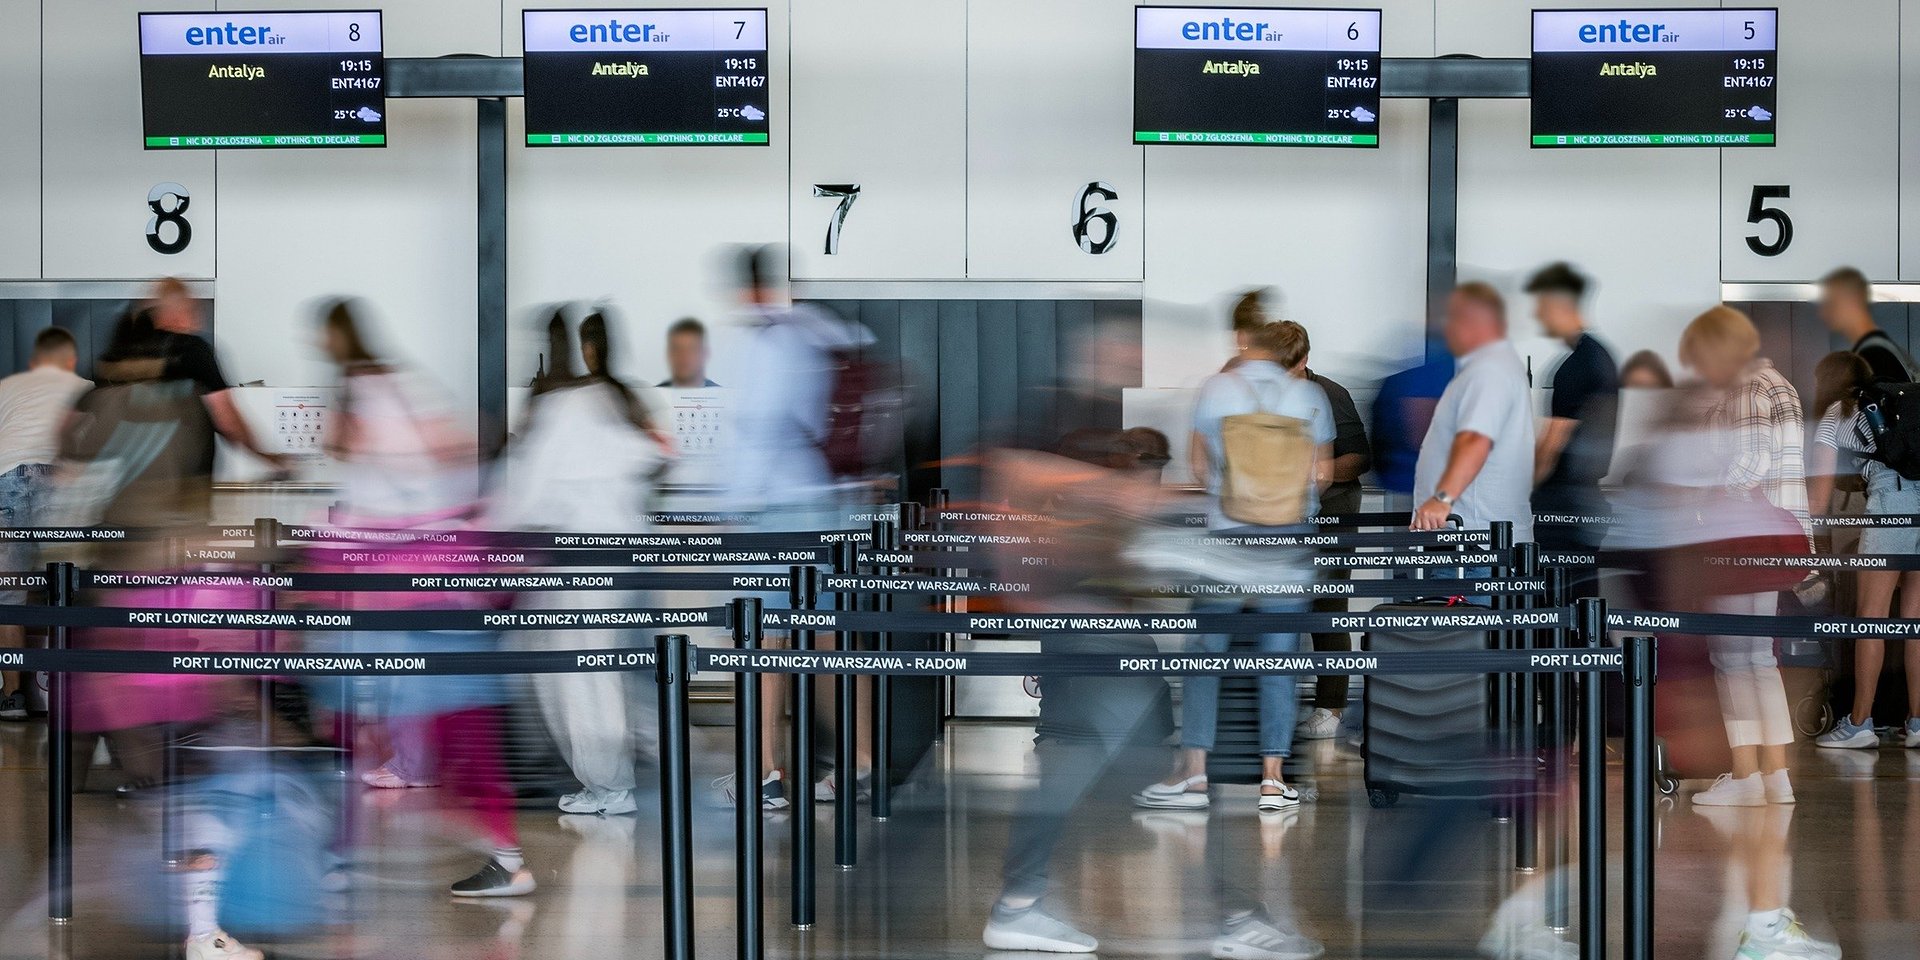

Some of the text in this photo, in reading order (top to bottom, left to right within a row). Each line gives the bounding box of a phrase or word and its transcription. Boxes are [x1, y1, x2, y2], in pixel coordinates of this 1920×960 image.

[186, 22, 286, 46] enter air
[349, 23, 361, 41] 8
[569, 19, 670, 43] enter air
[733, 21, 746, 40] 7
[1182, 18, 1283, 42] enter air
[1347, 21, 1359, 40] 6
[1578, 19, 1679, 43] enter air
[1744, 21, 1755, 40] 5
[340, 60, 371, 71] 19:15
[591, 61, 649, 78] Antalya
[724, 59, 756, 69] 19:15
[1202, 60, 1260, 77] Antalya
[1337, 59, 1368, 70] 19:15
[1733, 59, 1765, 70] 19:15
[208, 64, 265, 80] Antalya
[1599, 62, 1657, 78] Antalya
[331, 78, 381, 89] ENT4167
[715, 76, 765, 87] ENT4167
[1327, 77, 1377, 88] ENT4167
[1724, 76, 1774, 87] ENT4167
[202, 137, 213, 145] DO
[312, 136, 323, 144] TO
[325, 136, 360, 144] DECLARE
[568, 134, 743, 143] NIC DO NOTHING TO DECLARE
[1192, 134, 1203, 142] DO
[1266, 135, 1302, 143] NOTHING
[1304, 135, 1315, 143] TO
[1317, 135, 1352, 143] DECLARE
[1574, 135, 1749, 144] NIC DO NOTHING DECLARE
[145, 181, 192, 254] 8
[813, 184, 861, 255] 7
[1071, 180, 1120, 255] 6
[1745, 185, 1793, 257] 5
[849, 513, 871, 522] PORT
[965, 513, 1006, 521] LOTNICZY
[1008, 514, 1056, 522] WARSZAWA
[1538, 515, 1579, 523] LOTNICZY
[33, 530, 125, 539] WARSZAWA RADOM
[223, 529, 247, 537] PORT
[291, 529, 457, 542] PORT LOTNICZY WARSZAWA RADOM
[820, 533, 845, 542] PORT
[905, 533, 1031, 544] PORT LOTNICZY WARSZAWA
[1437, 534, 1461, 542] PORT
[555, 536, 722, 546] PORT LOTNICZY WARSZAWA RADOM
[1198, 538, 1243, 546] LOTNICZY
[1244, 537, 1296, 545] WARSZAWA
[199, 550, 235, 559] RADOM
[343, 553, 524, 563] PORT LOTNICZY WARSZAWA RADOM
[632, 551, 815, 563] PORT LOTNICZY WARSZAWA RADOM
[876, 554, 913, 563] RADOM
[1314, 554, 1497, 566] PORT LOTNICZY WARSZAWA RADOM
[1558, 555, 1595, 564] RADOM
[1022, 557, 1048, 566] PORT
[1734, 558, 1887, 567] LOTNICZY WARSZAWA RADOM
[93, 575, 293, 587] PORT LOTNICZY WARSZAWA RADOM
[412, 577, 613, 587] PORT LOTNICZY WARSZAWA RADOM
[733, 577, 763, 587] PORT
[828, 578, 1030, 592] PORT LOTNICZY WARSZAWA RADOM
[1475, 582, 1505, 591] PORT
[1184, 584, 1354, 594] LOTNICZY WARSZAWA RADOM
[129, 613, 351, 626] PORT LOTNICZY WARSZAWA RADOM
[484, 612, 707, 625] PORT LOTNICZY WARSZAWA RADOM
[791, 614, 836, 625] RADOM
[970, 618, 1197, 629] PORT LOTNICZY WARSZAWA RADOM
[1332, 613, 1559, 628] PORT LOTNICZY WARSZAWA RADOM
[1634, 616, 1680, 628] RADOM
[1814, 622, 1847, 634] PORT
[1850, 623, 1911, 634] LOTNICZY
[173, 657, 426, 670] PORT LOTNICZY WARSZAWA RADOM
[577, 655, 615, 667] PORT
[710, 655, 967, 670] PORT LOTNICZY WARSZAWA RADOM
[1120, 657, 1378, 671] PORT LOTNICZY WARSZAWA RADOM
[1531, 654, 1569, 667] PORT
